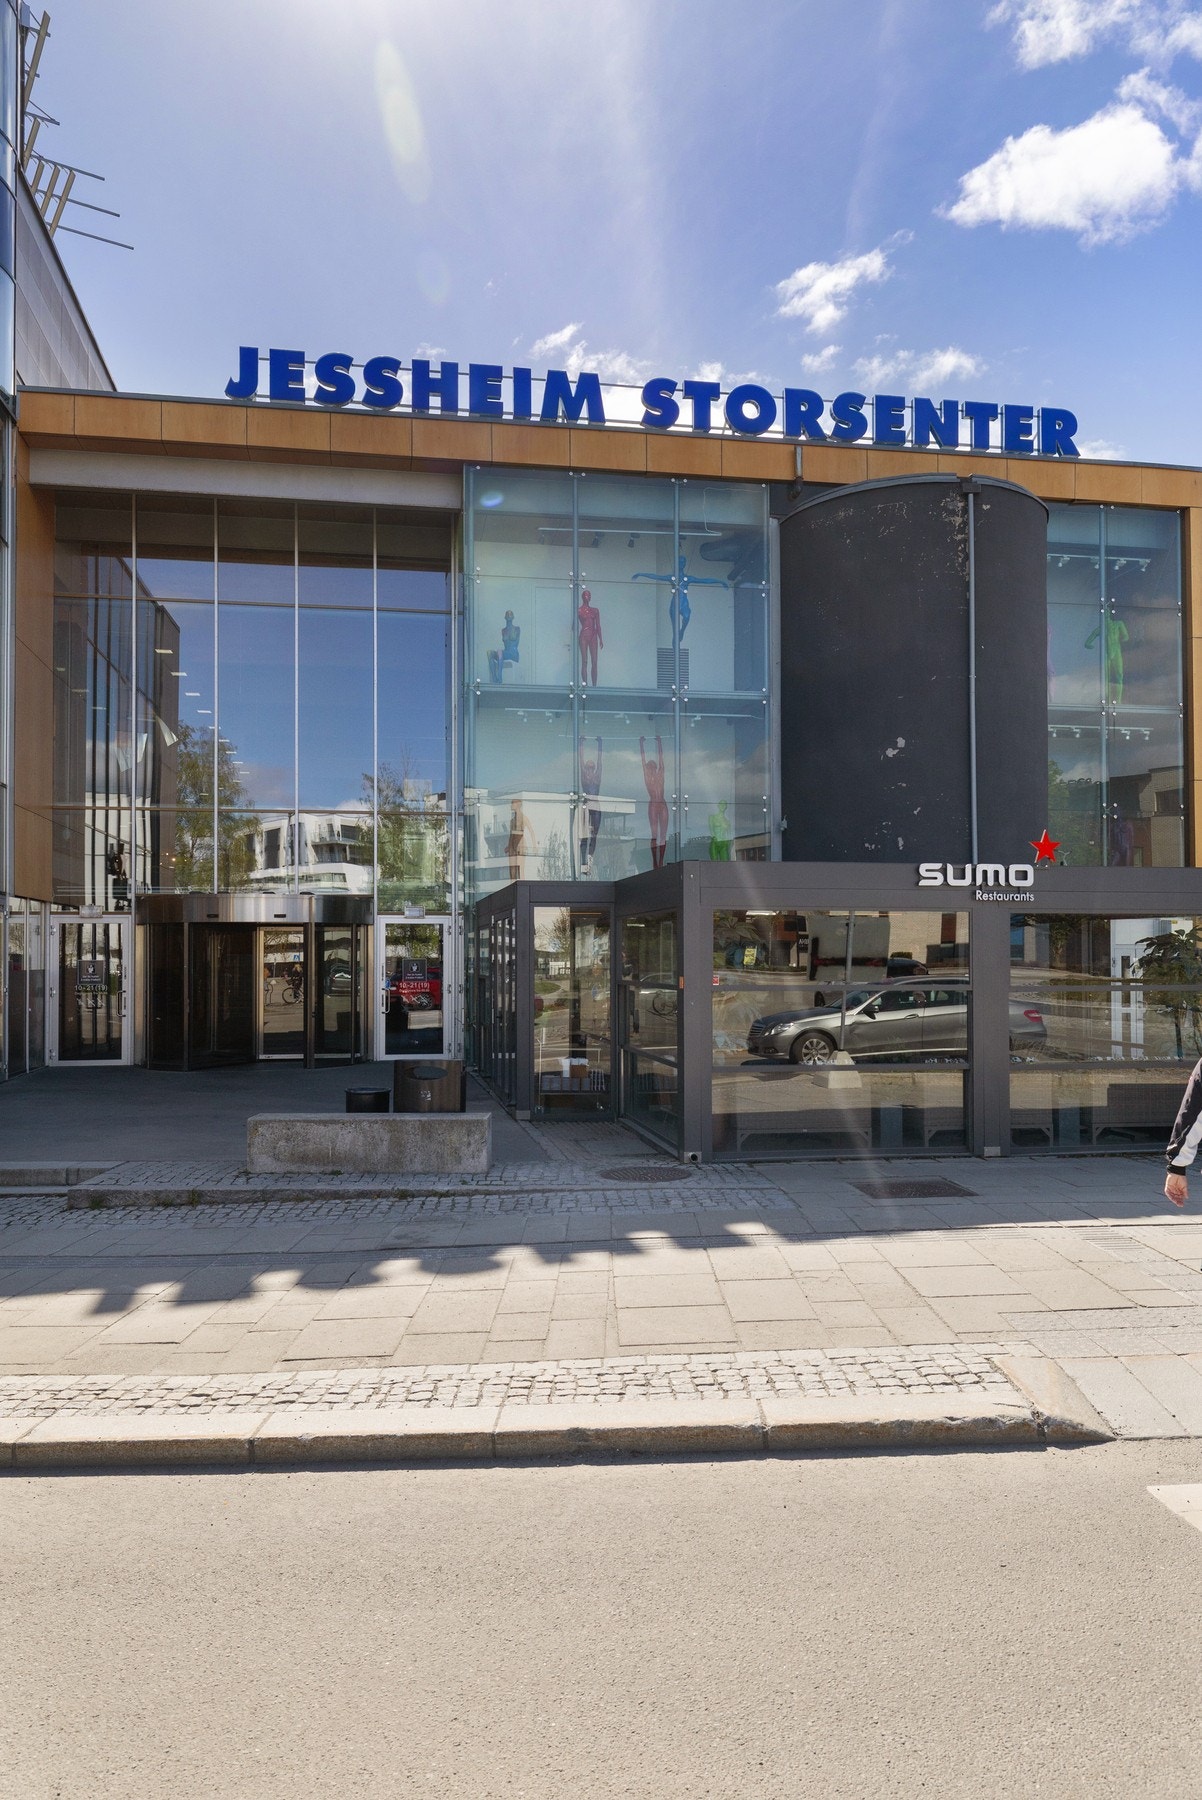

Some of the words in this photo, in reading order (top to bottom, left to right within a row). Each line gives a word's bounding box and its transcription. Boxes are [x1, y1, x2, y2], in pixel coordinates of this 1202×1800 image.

[225, 345, 606, 424] JESSHEIM
[640, 377, 1080, 457] STORSENTER
[918, 863, 1035, 887] SUMO
[975, 890, 1035, 902] Restaurants
